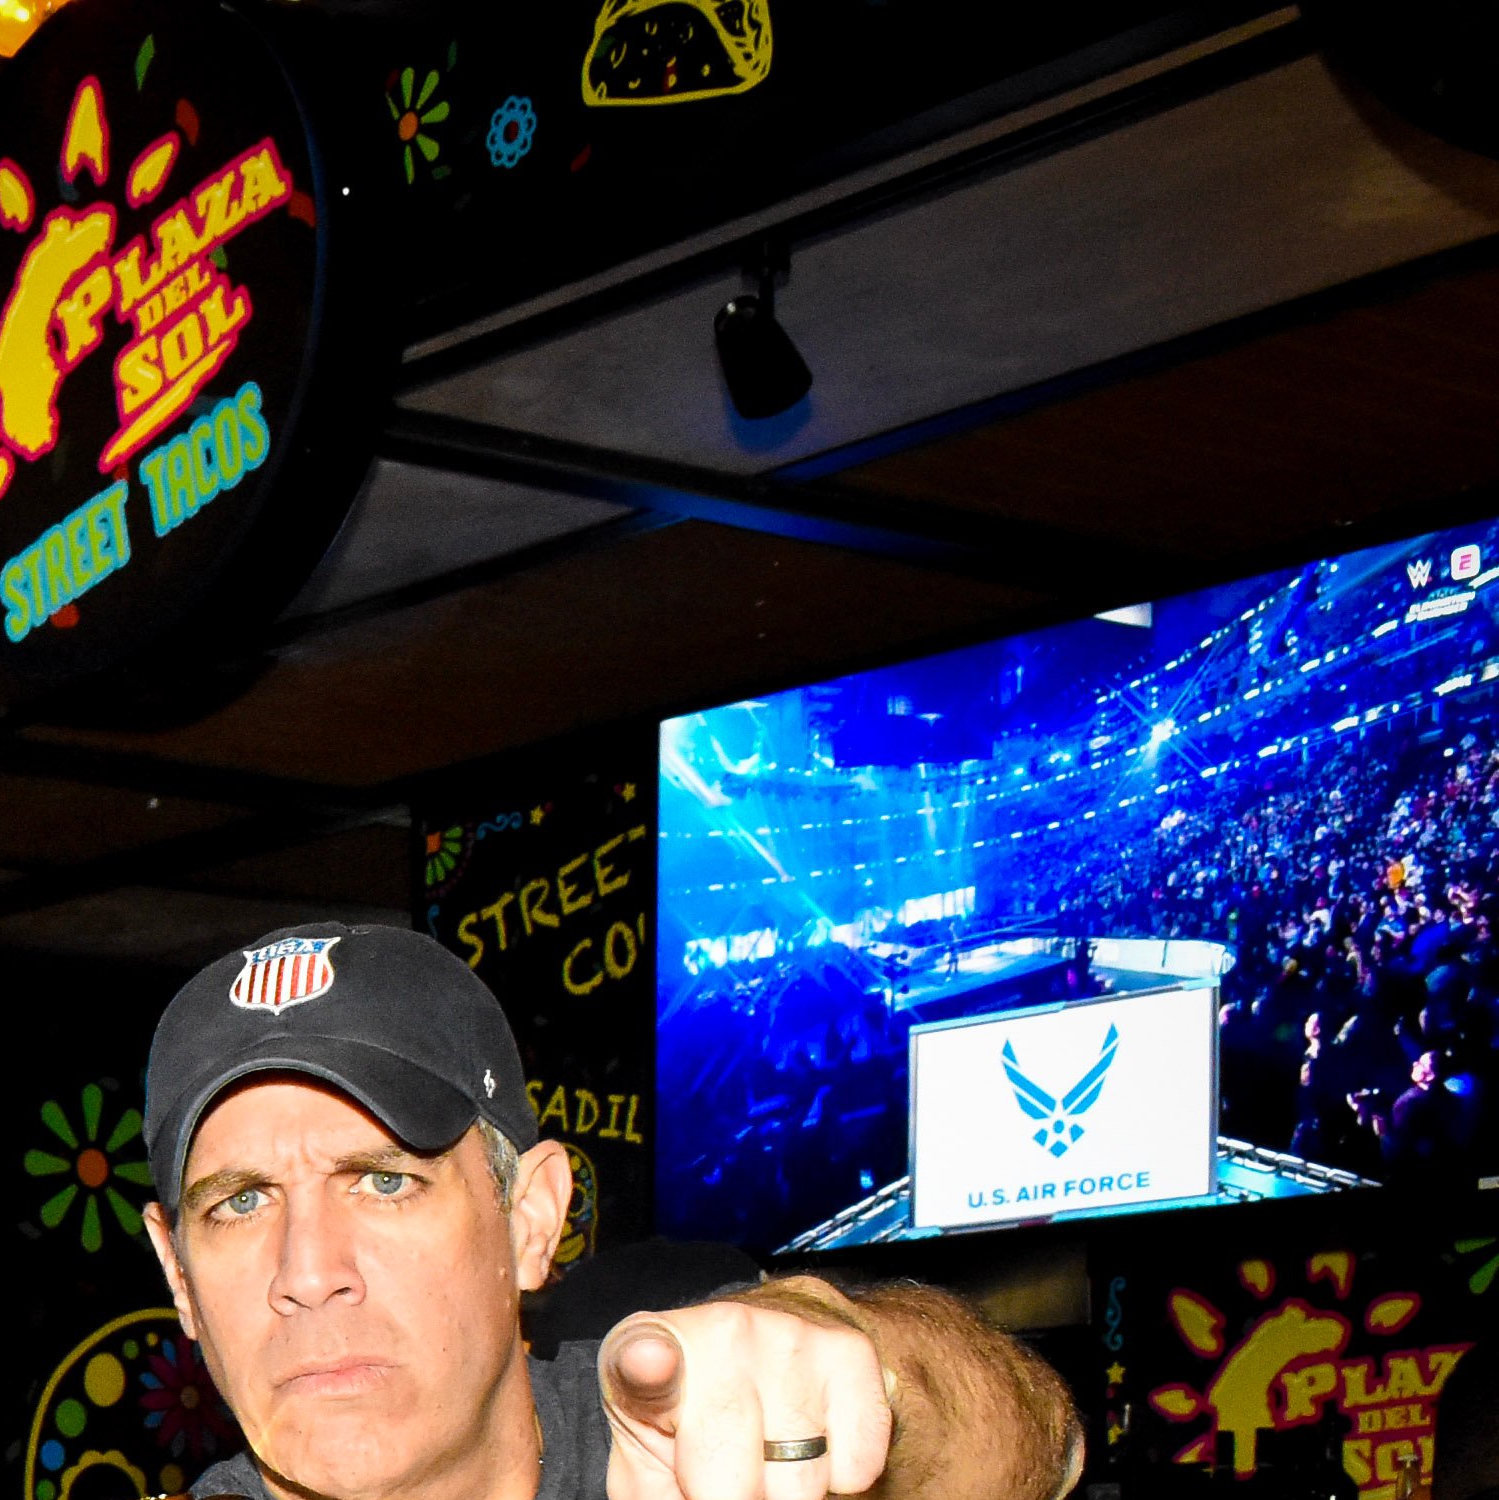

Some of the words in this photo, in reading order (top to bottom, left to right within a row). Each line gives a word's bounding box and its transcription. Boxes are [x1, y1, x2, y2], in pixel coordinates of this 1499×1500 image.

[53, 142, 289, 366] PLAZA
[134, 260, 212, 338] DEL
[115, 283, 246, 416] SOL
[1, 483, 129, 639] STREET
[141, 384, 268, 534] TACOS
[457, 824, 647, 969] STREE
[562, 912, 646, 996] CO
[968, 1189, 1010, 1208] U.S.
[1016, 1183, 1056, 1203] AIR
[1064, 1171, 1150, 1198] FORCE
[1280, 1350, 1467, 1422] PLAZ
[1357, 1403, 1432, 1435] DEL
